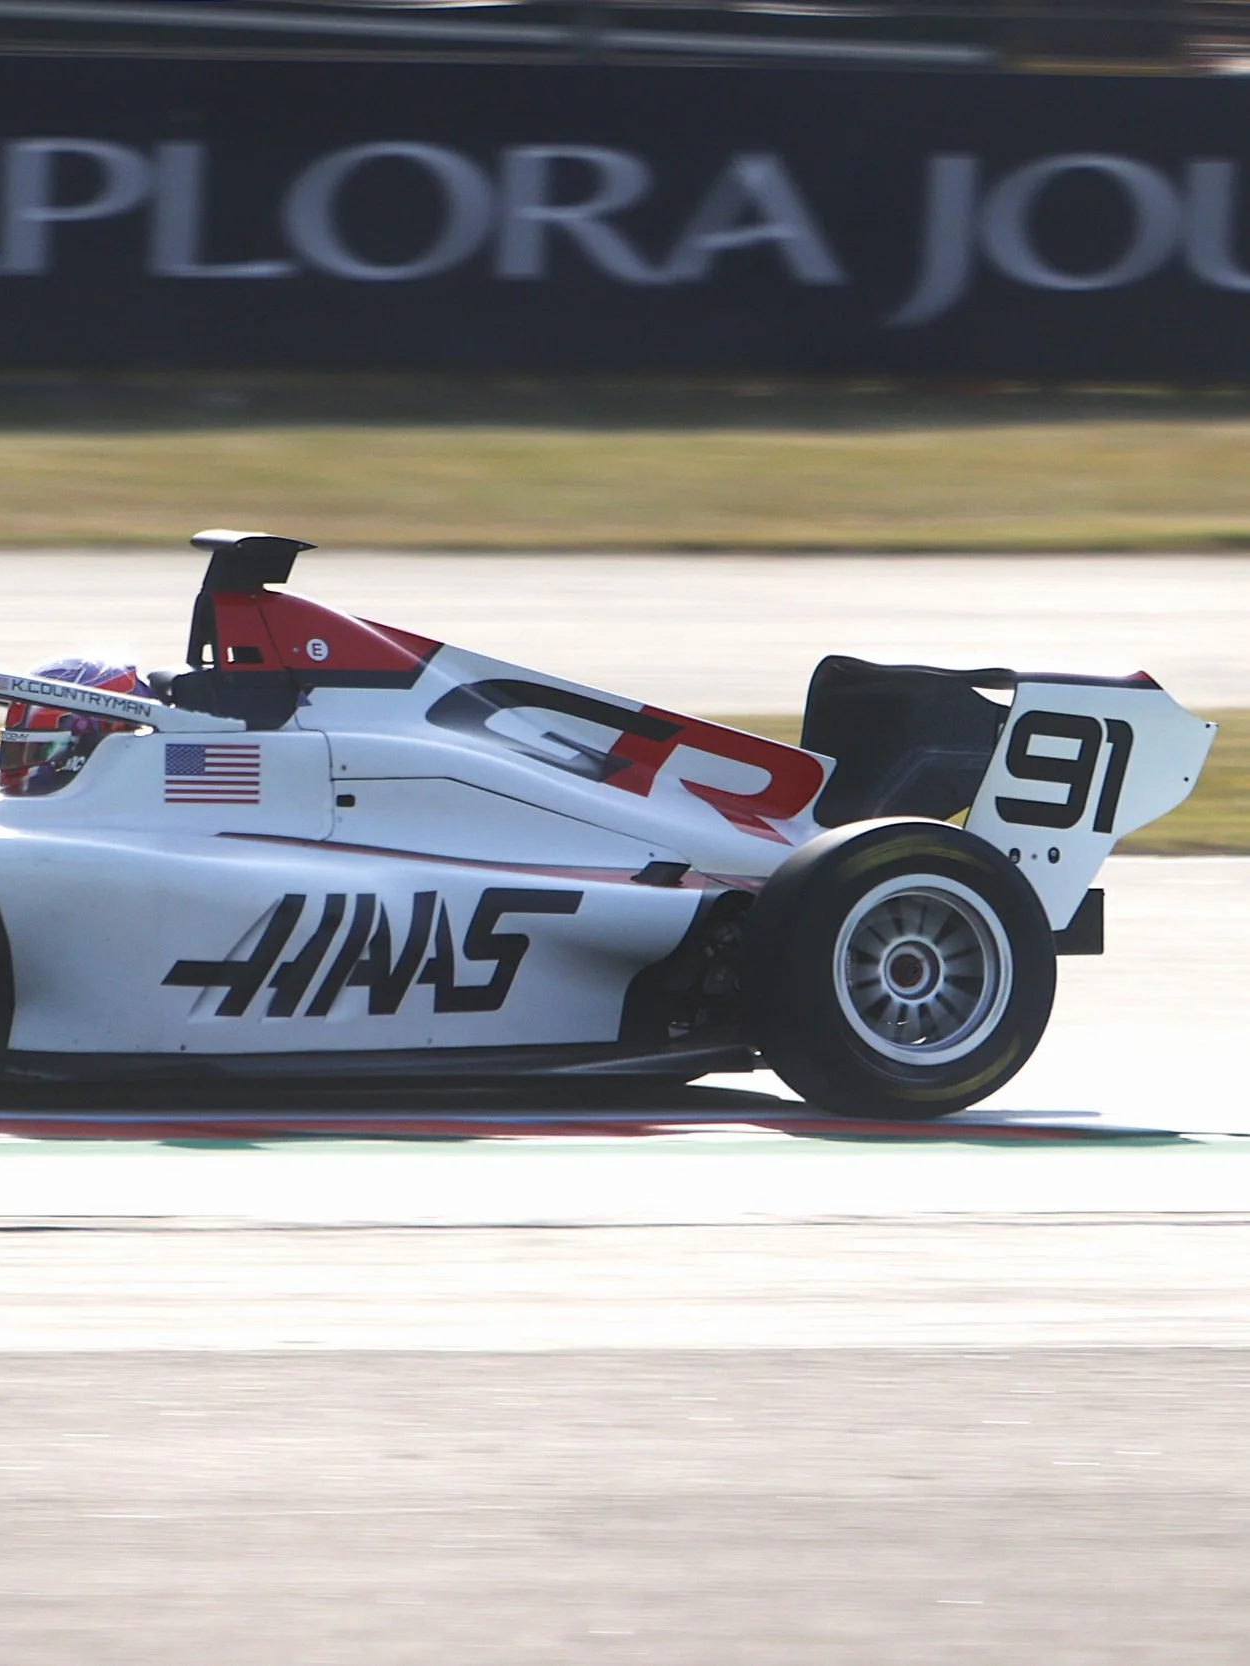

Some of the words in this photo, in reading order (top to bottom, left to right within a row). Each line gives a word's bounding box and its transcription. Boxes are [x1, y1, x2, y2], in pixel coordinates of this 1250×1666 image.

[312, 643, 323, 657] E
[11, 678, 151, 718] K.COUNTRYMAN
[995, 710, 1134, 834] 91
[161, 886, 584, 1018] HAAS
